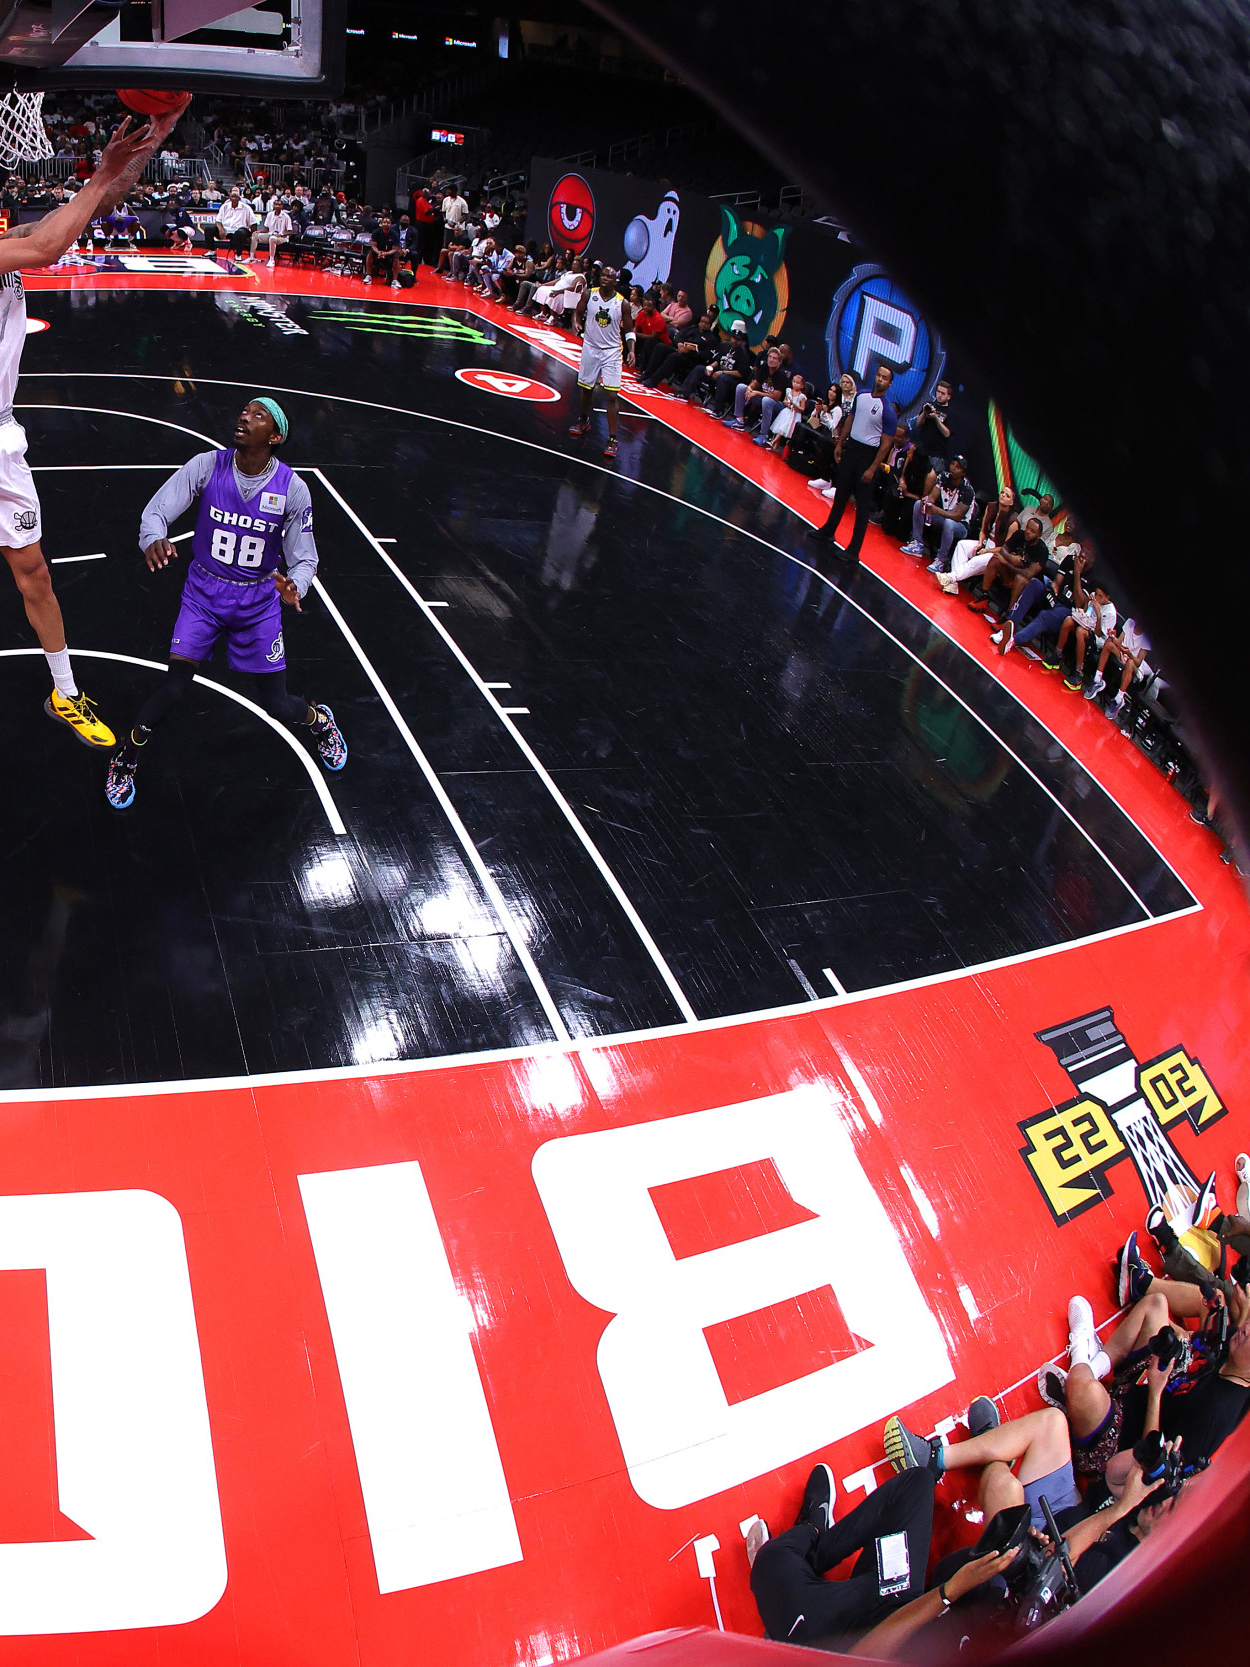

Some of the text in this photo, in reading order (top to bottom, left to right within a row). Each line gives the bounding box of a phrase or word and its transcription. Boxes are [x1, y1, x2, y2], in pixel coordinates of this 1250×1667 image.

[453, 39, 477, 49] Microsoft
[209, 504, 279, 534] GHOST
[210, 528, 266, 568] 88
